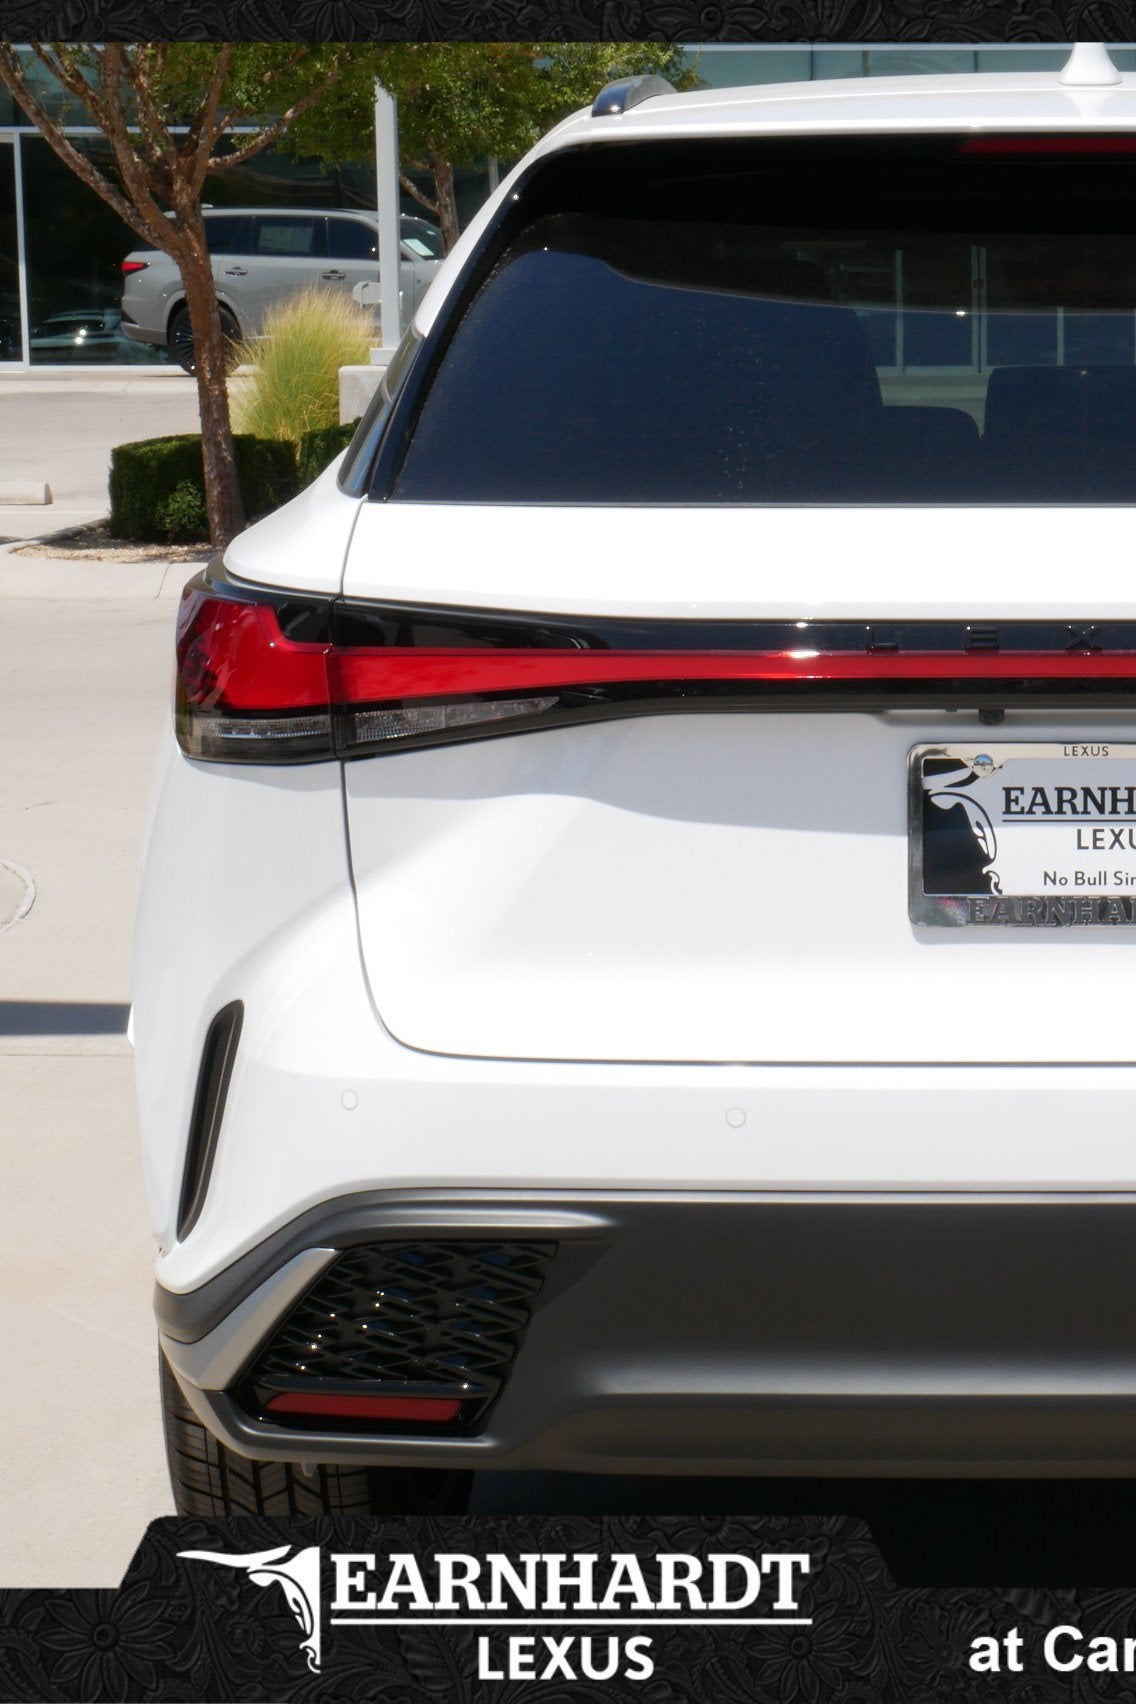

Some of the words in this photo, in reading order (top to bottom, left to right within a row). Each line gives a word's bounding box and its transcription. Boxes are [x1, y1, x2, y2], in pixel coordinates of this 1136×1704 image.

[1063, 745, 1110, 757] LEXUS
[1043, 871, 1068, 886] No
[1074, 870, 1107, 886] Bull
